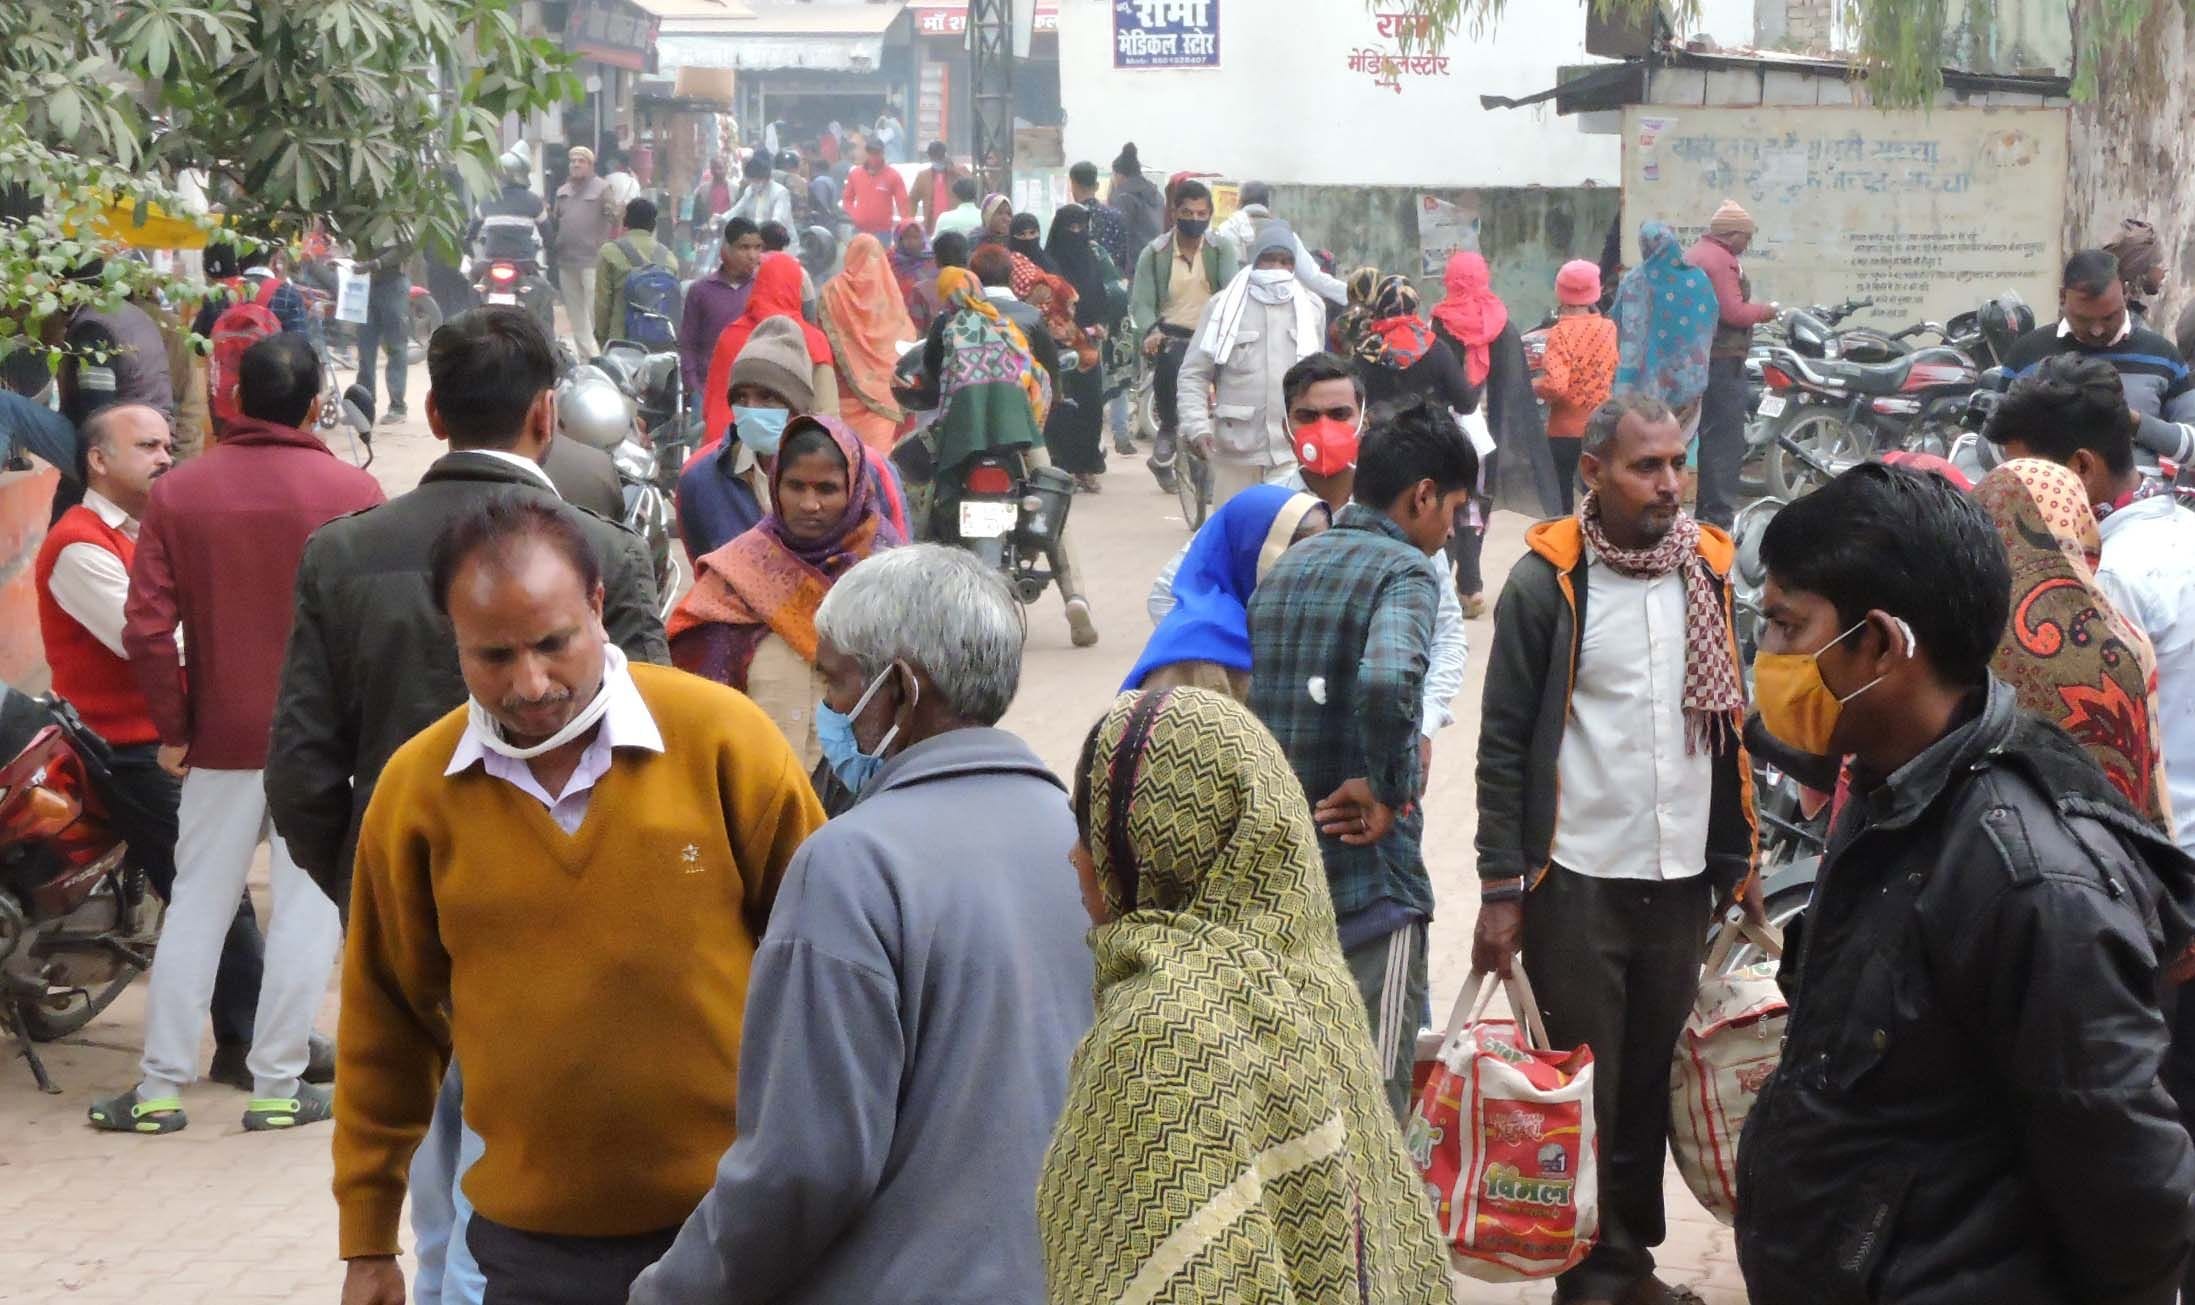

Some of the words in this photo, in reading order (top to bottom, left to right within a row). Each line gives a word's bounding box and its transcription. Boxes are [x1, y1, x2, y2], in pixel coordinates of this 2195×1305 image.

[1117, 28, 1178, 55] मेडिकल
[1181, 27, 1216, 55] स्टोर
[1347, 47, 1410, 74] मेडिल
